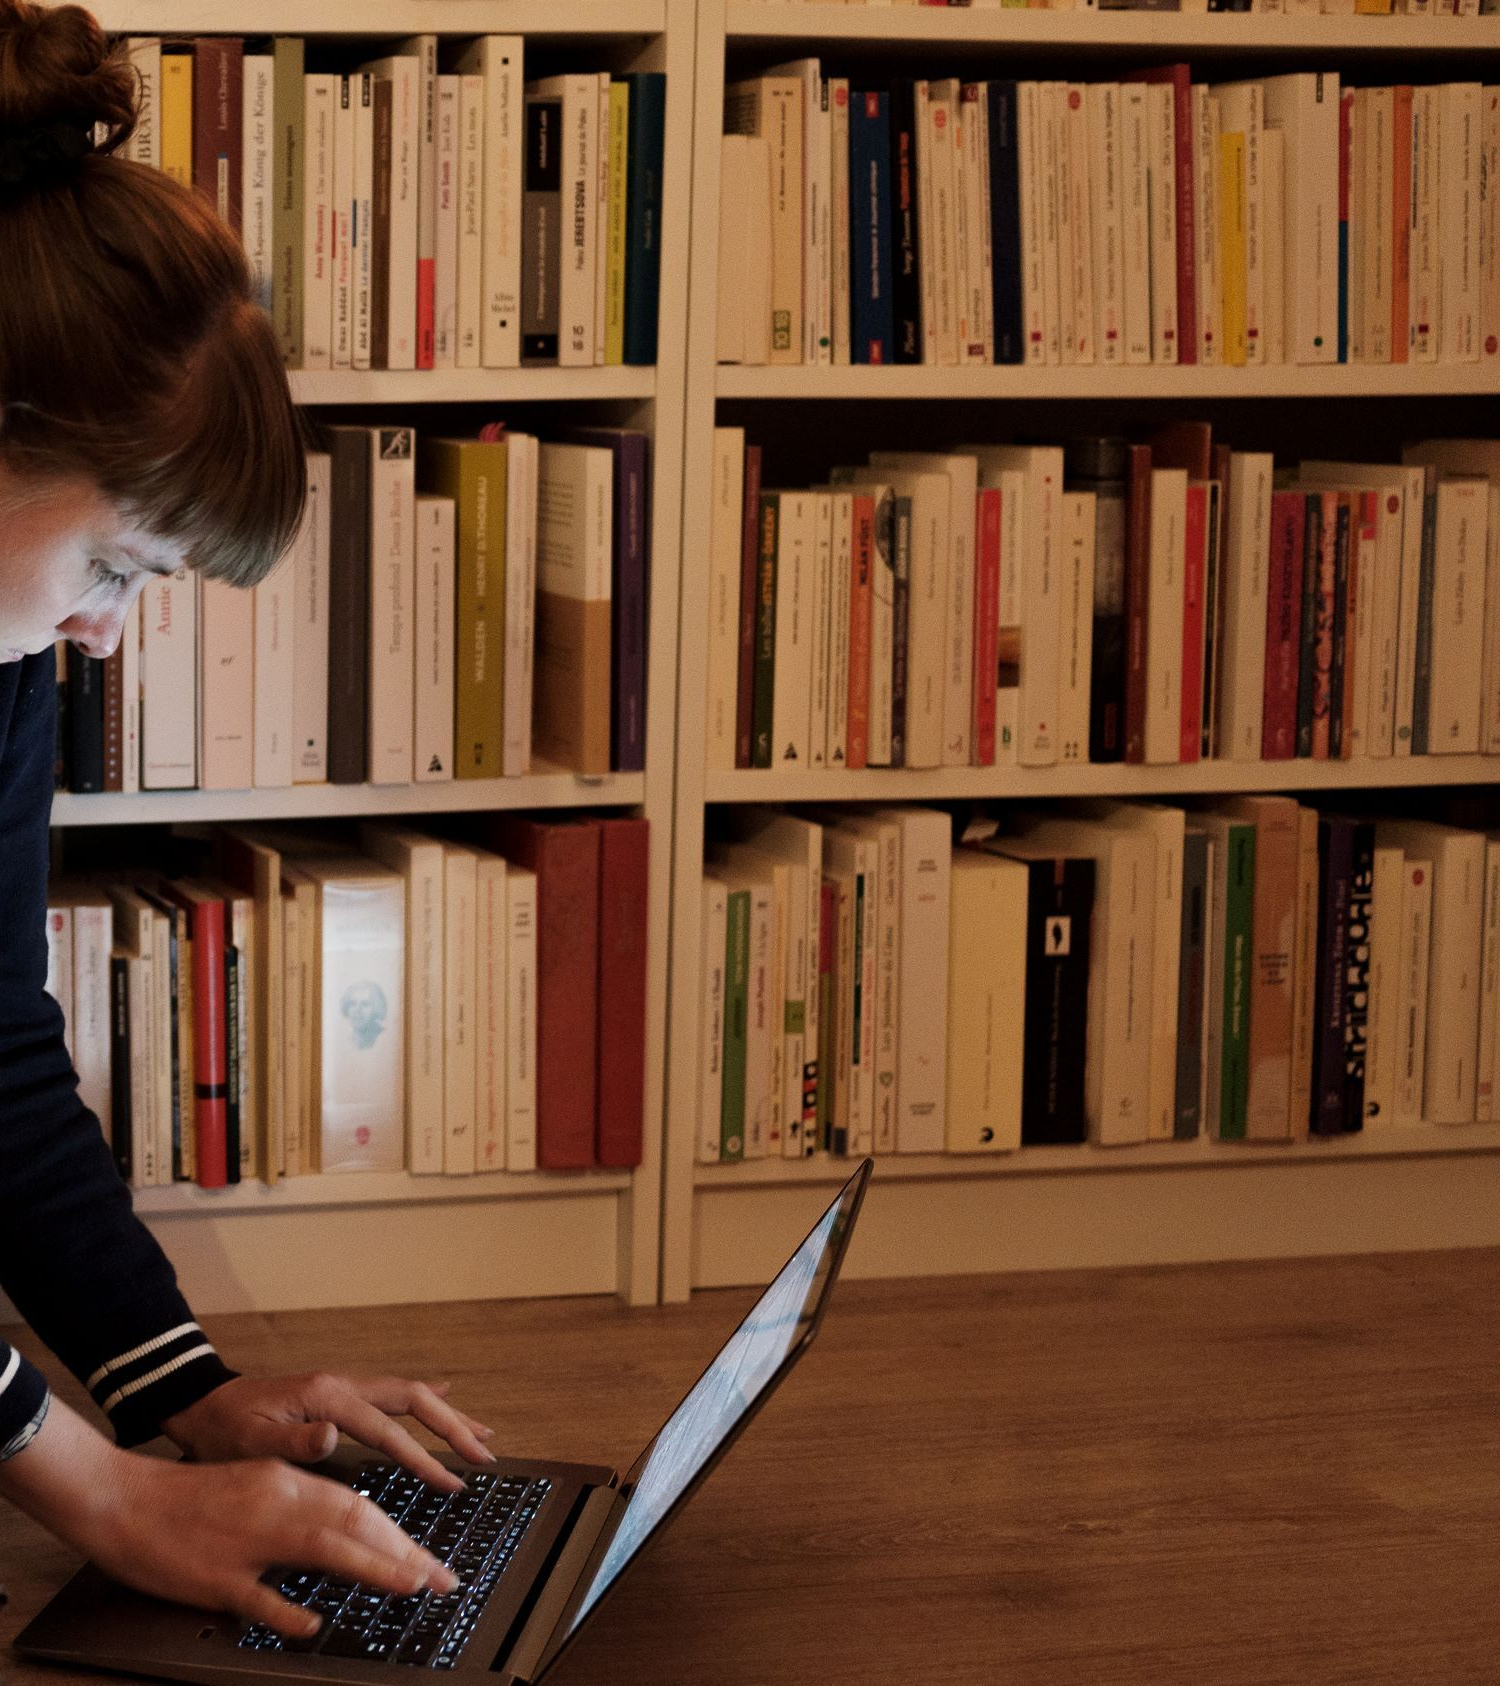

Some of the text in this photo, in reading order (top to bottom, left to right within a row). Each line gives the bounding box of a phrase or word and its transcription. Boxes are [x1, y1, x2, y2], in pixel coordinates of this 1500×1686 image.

[218, 51, 229, 131] Louis Chevalier
[252, 71, 266, 189] König der Könige
[157, 586, 172, 635] Annie
[475, 620, 485, 682] WALDEN
